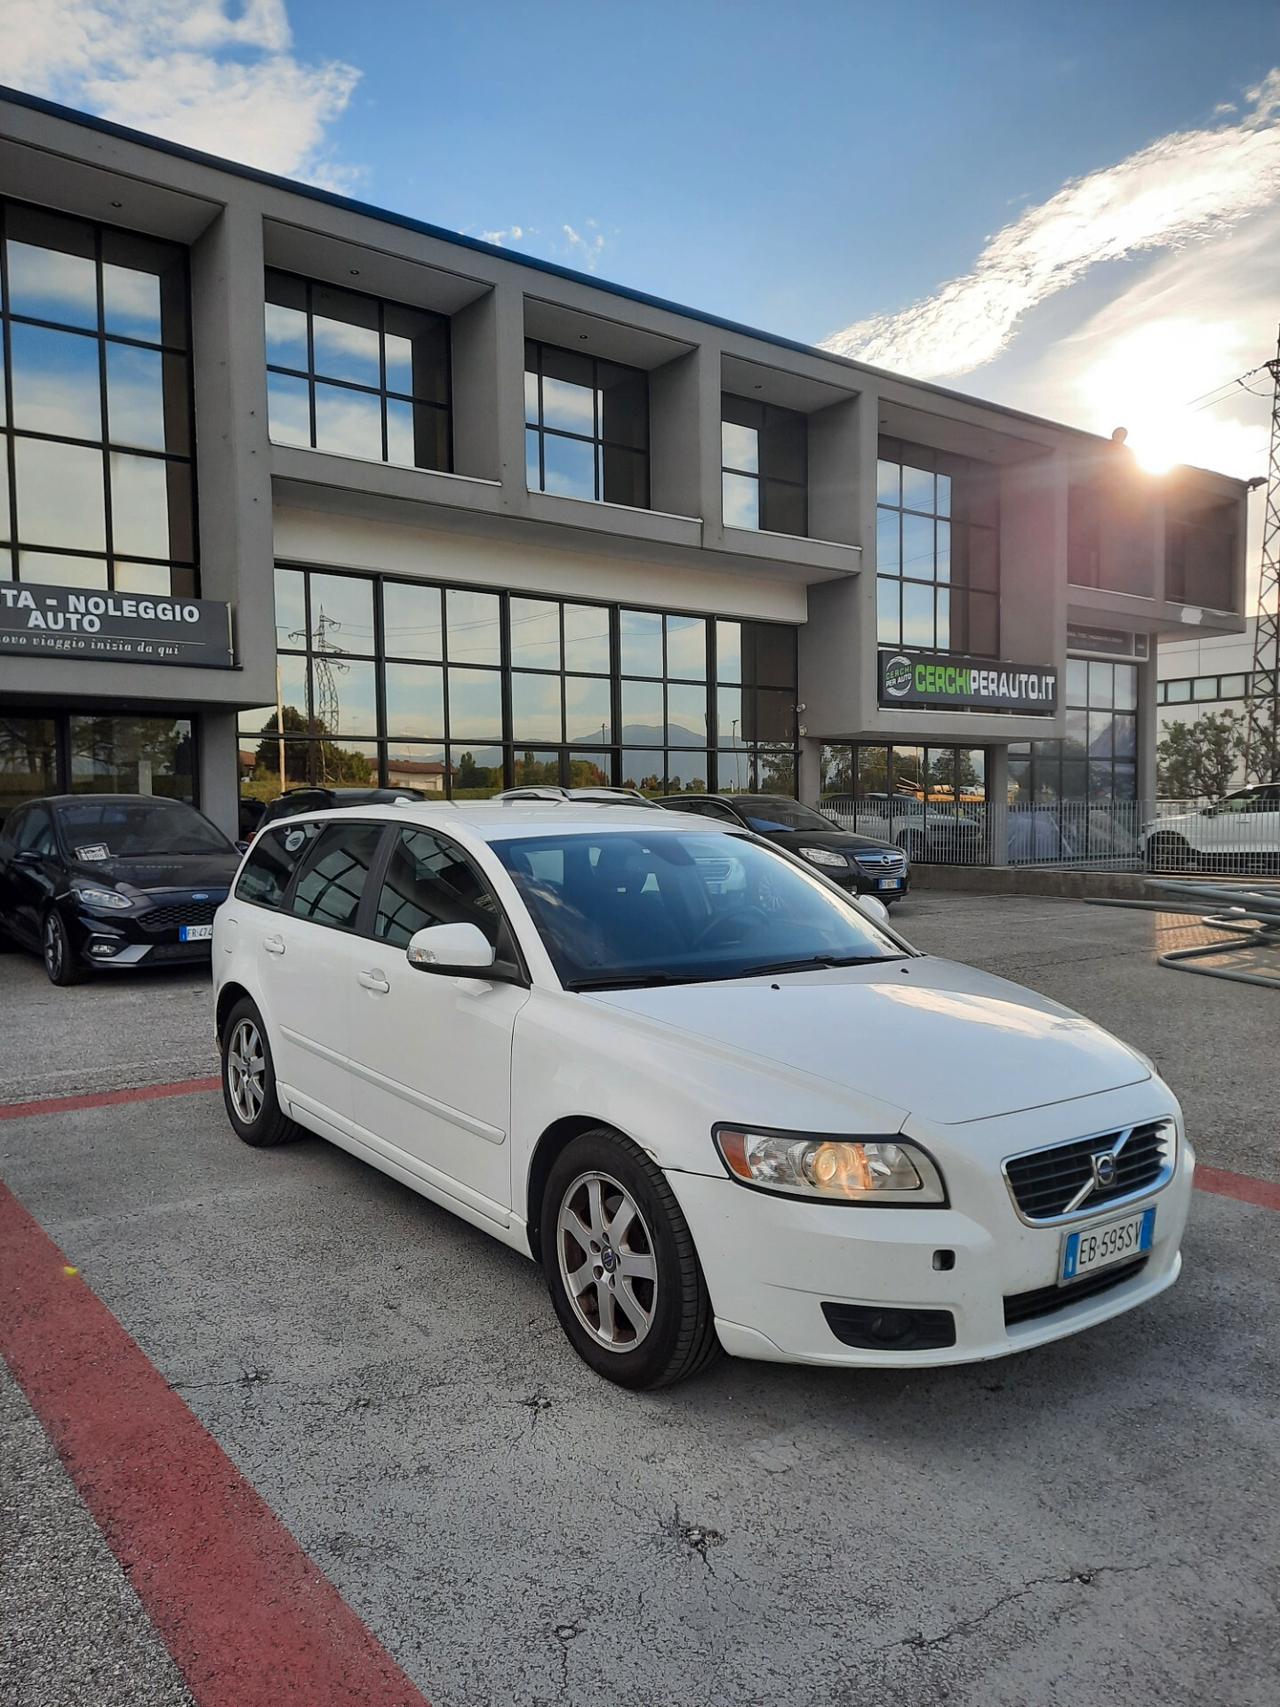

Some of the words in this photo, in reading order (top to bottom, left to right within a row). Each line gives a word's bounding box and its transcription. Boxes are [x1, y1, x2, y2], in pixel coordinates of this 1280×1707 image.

[68, 594, 200, 623] NOLEGGIO
[27, 610, 101, 633] AUTO
[32, 634, 85, 650] viaggio
[91, 638, 132, 652] inizia
[137, 643, 153, 653] da
[158, 645, 179, 657] qui
[885, 665, 912, 680] CERCHI
[915, 664, 1055, 700] CERCHIPERAUTO.IT
